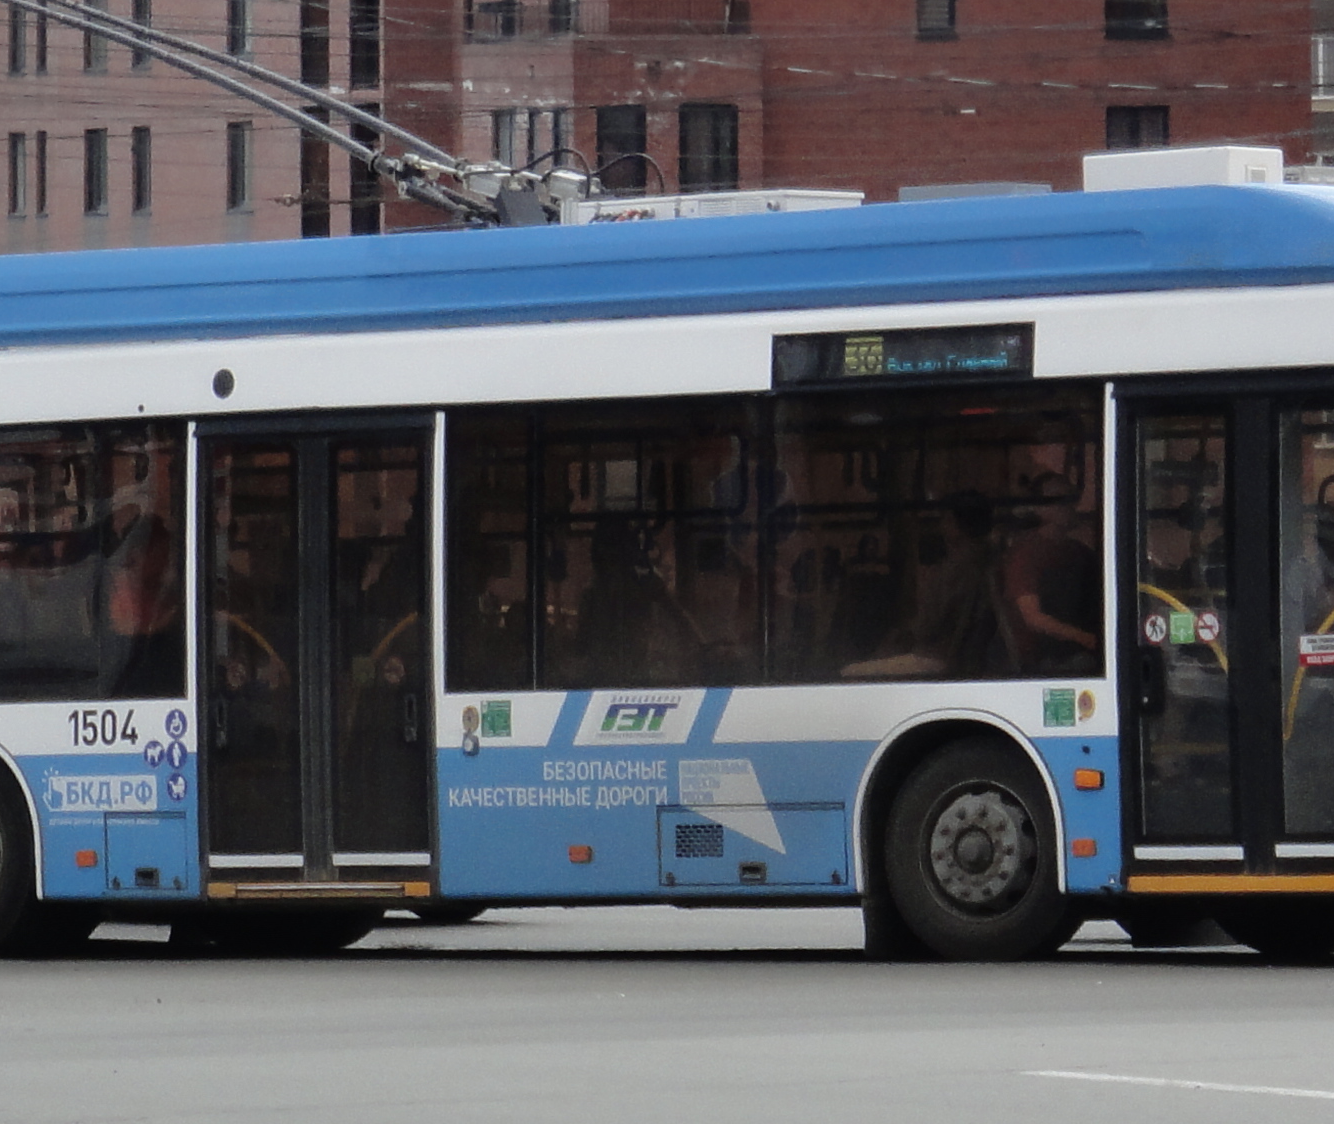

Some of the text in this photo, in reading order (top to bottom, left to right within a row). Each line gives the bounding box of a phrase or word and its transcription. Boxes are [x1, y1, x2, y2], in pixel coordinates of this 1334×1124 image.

[68, 709, 138, 746] 1504
[543, 761, 667, 781] БЕЗОПАСНЫЕ
[67, 781, 153, 808] БКД.РФ
[449, 787, 591, 807] КАЧЕСТВЕННЫЕ
[595, 786, 667, 810] ДОРОГИ
